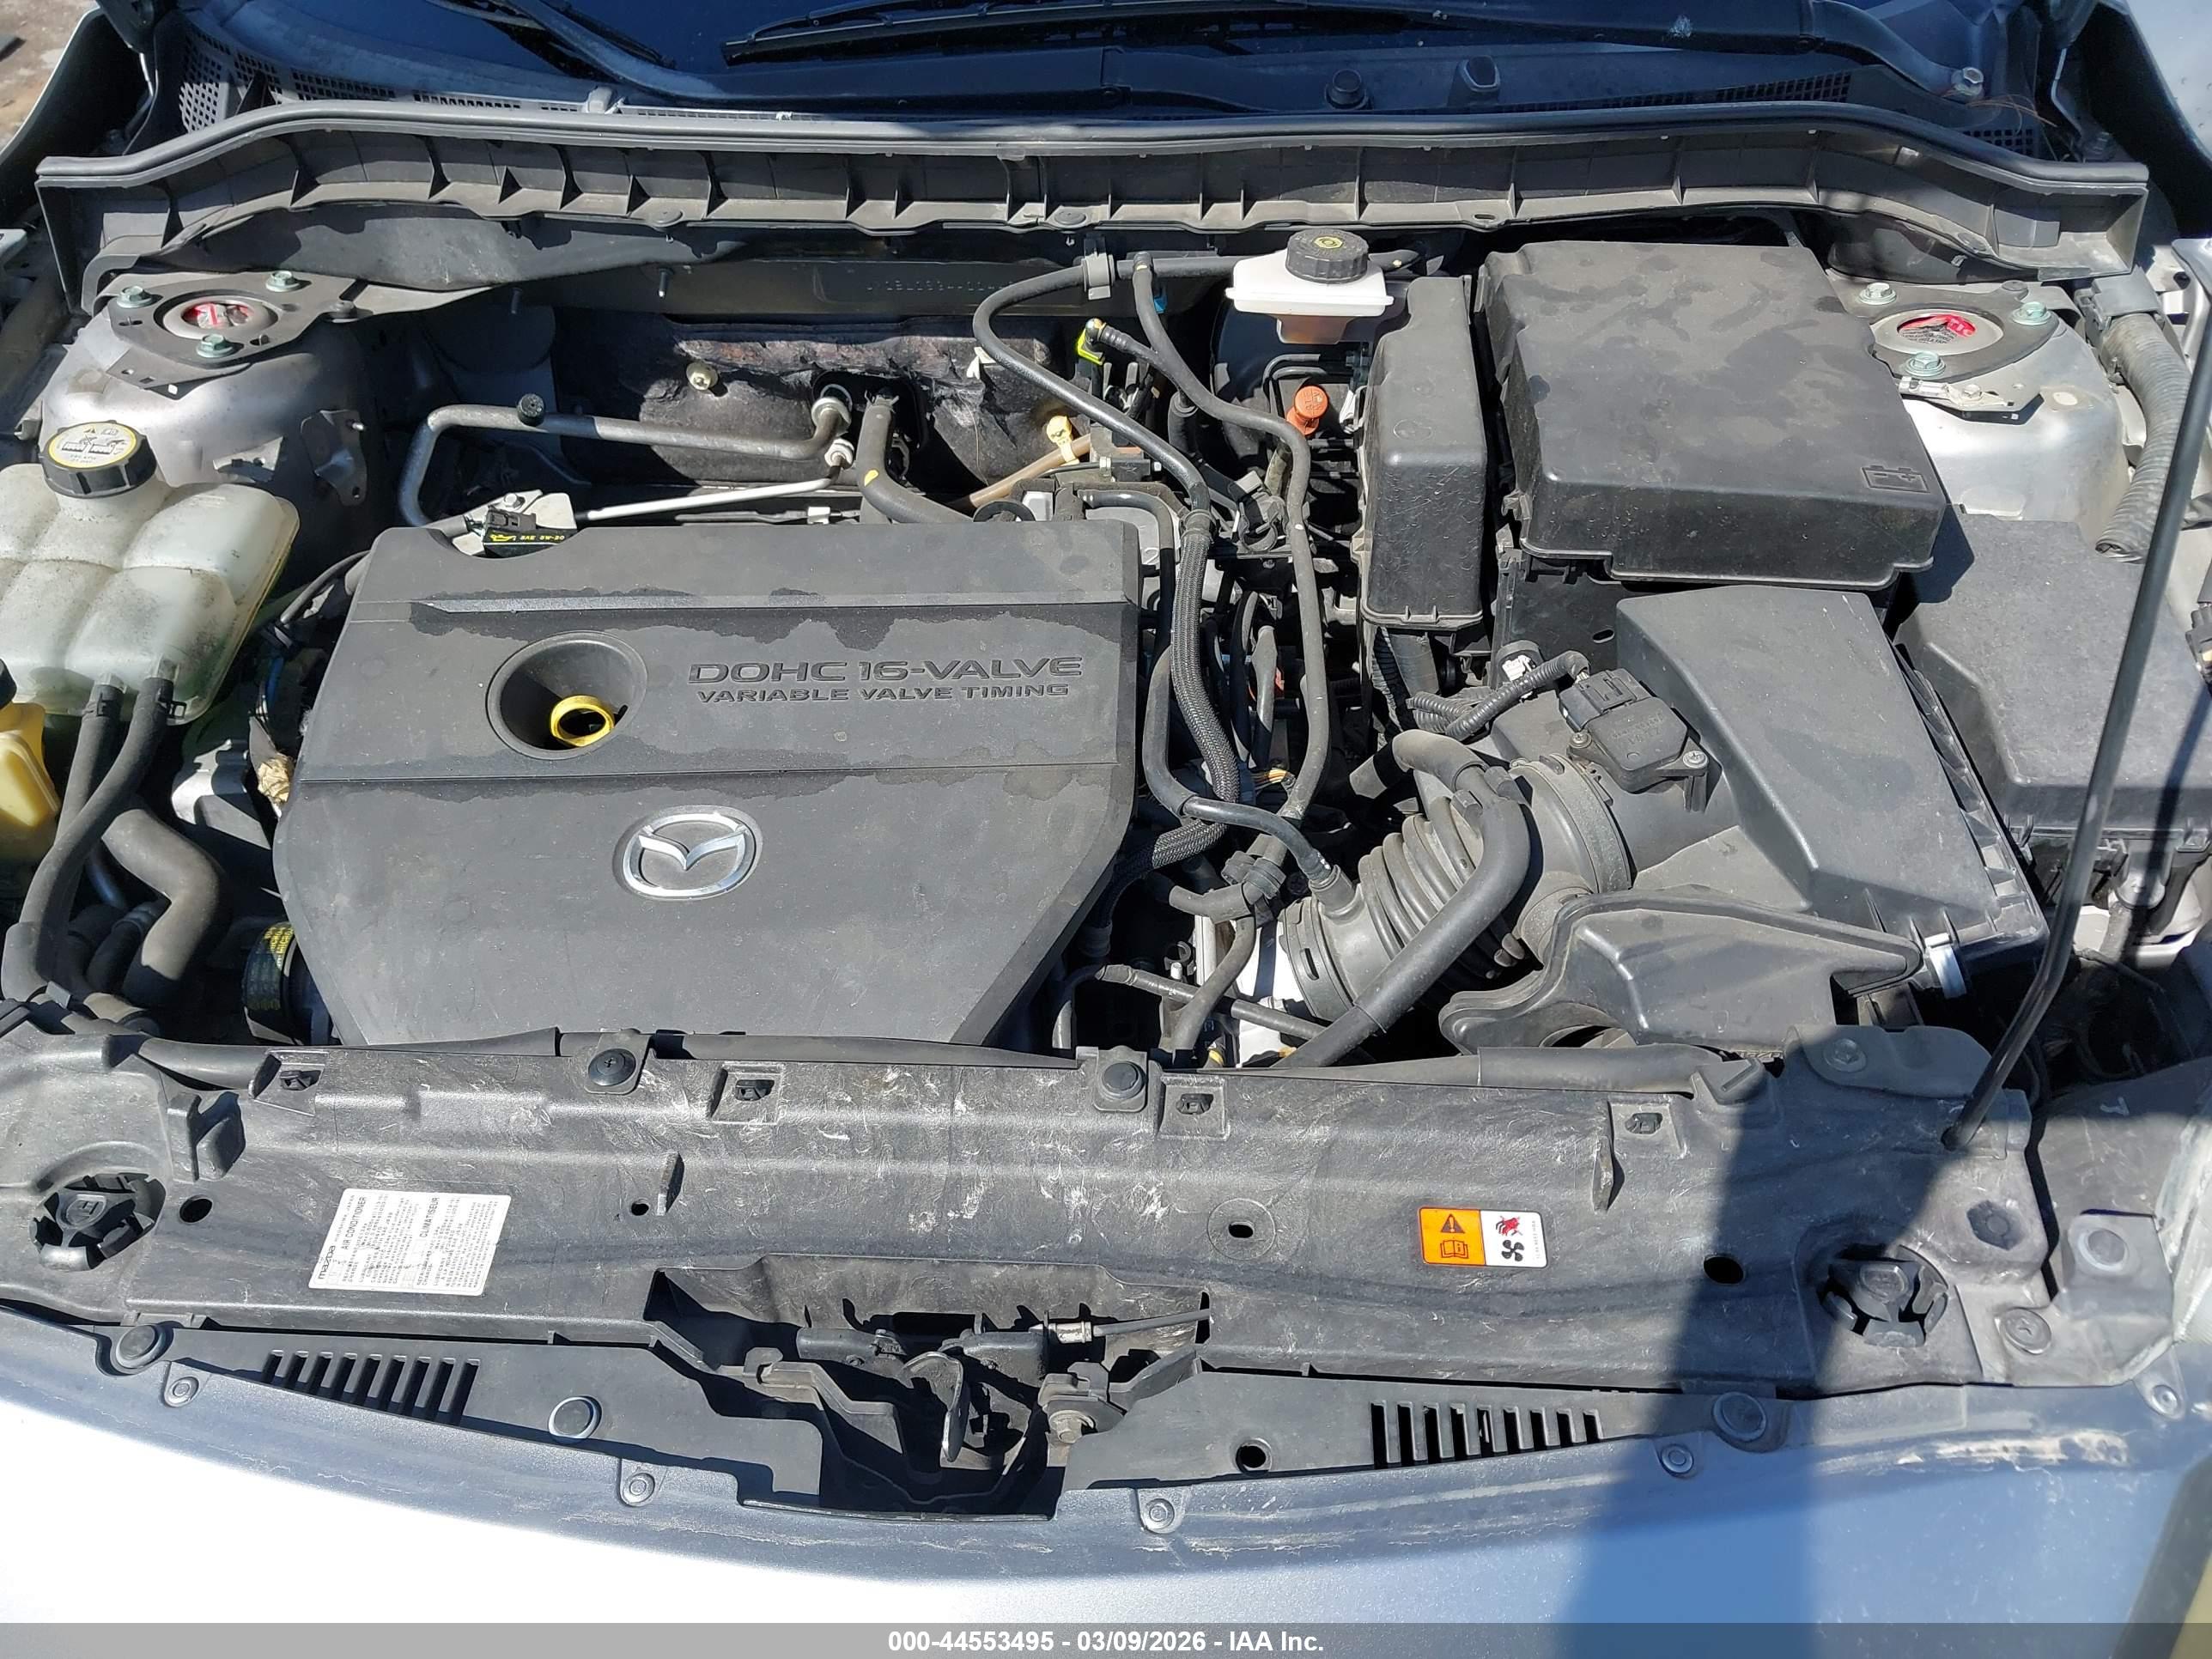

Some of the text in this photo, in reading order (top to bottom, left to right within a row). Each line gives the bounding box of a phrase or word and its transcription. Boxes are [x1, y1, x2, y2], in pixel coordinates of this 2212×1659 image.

[688, 656, 1084, 684] DOHC 16-VALVE
[696, 683, 1069, 703] VARIABLE VALVE TIMING
[341, 1197, 365, 1249] AIR CONDITIONER
[419, 1197, 440, 1237] CLIMATISEUR
